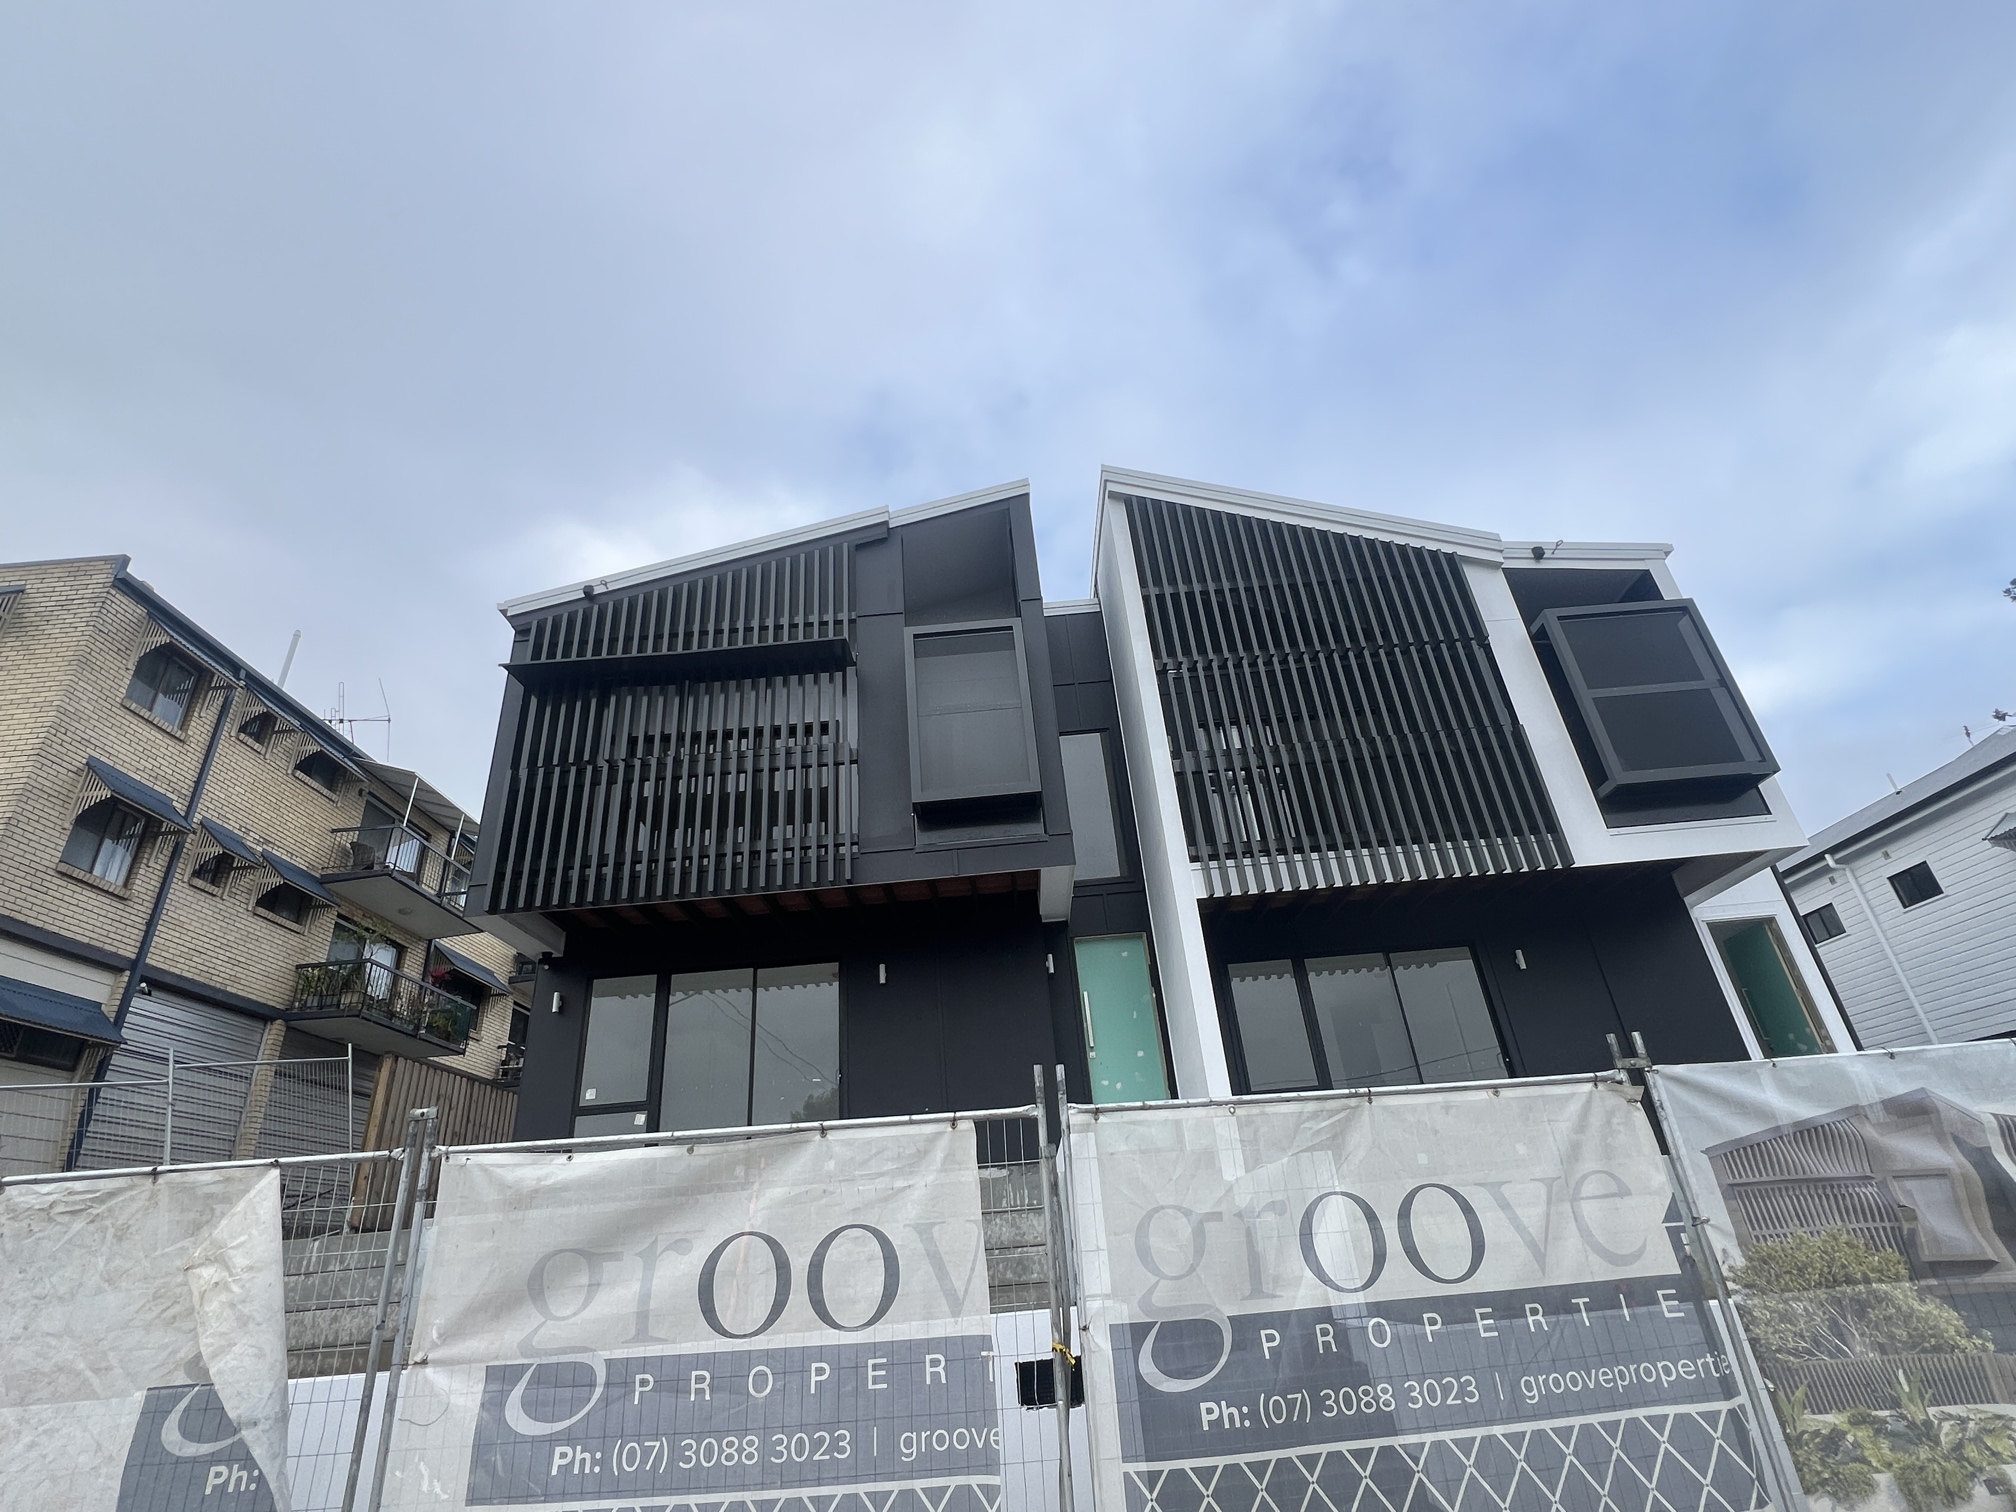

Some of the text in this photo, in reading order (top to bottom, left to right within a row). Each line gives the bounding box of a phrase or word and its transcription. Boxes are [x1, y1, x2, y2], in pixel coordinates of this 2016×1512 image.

[1134, 1168, 1648, 1393] groove
[504, 1219, 982, 1436] groov
[1259, 1289, 1685, 1359] PROPERTIE
[633, 1351, 995, 1405] PROPERT
[1200, 1400, 1250, 1431] Ph:
[1260, 1389, 1311, 1429] (07)
[1319, 1383, 1396, 1418] 3088
[1404, 1375, 1480, 1410] 3023
[1520, 1351, 1731, 1404] groovepropertie
[204, 1463, 260, 1496] Ph:
[551, 1445, 602, 1476] Ph:
[612, 1436, 668, 1476] (07)
[679, 1435, 759, 1469] 3088
[770, 1429, 851, 1464] 3023
[900, 1427, 1000, 1462] groove
